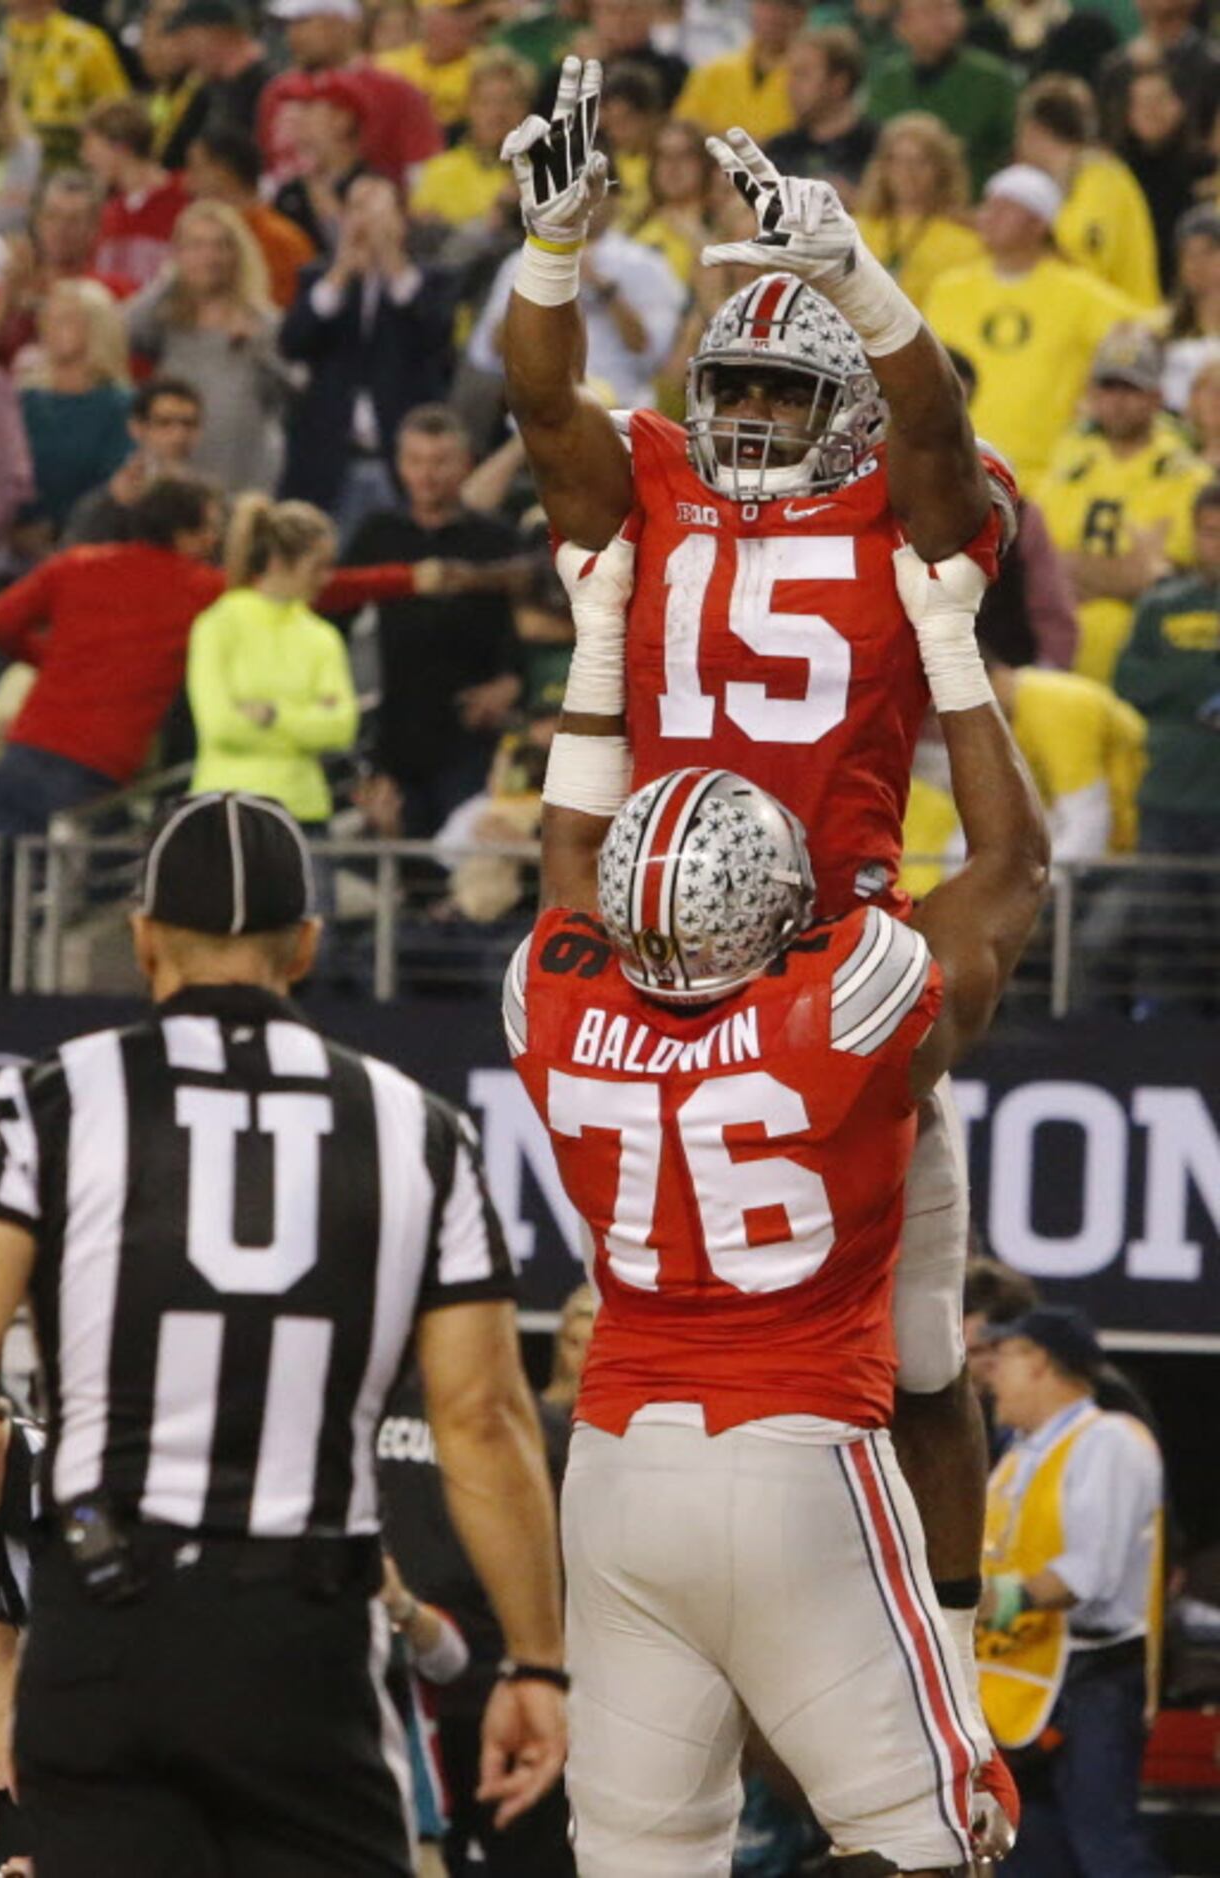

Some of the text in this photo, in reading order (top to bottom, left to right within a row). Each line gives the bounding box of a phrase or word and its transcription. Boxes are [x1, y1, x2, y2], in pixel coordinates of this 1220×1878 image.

[658, 533, 857, 744] 15
[572, 1006, 761, 1074] BALDWIN
[175, 1086, 334, 1294] U
[547, 1067, 837, 1295] 76
[378, 1415, 436, 1464] ECU
